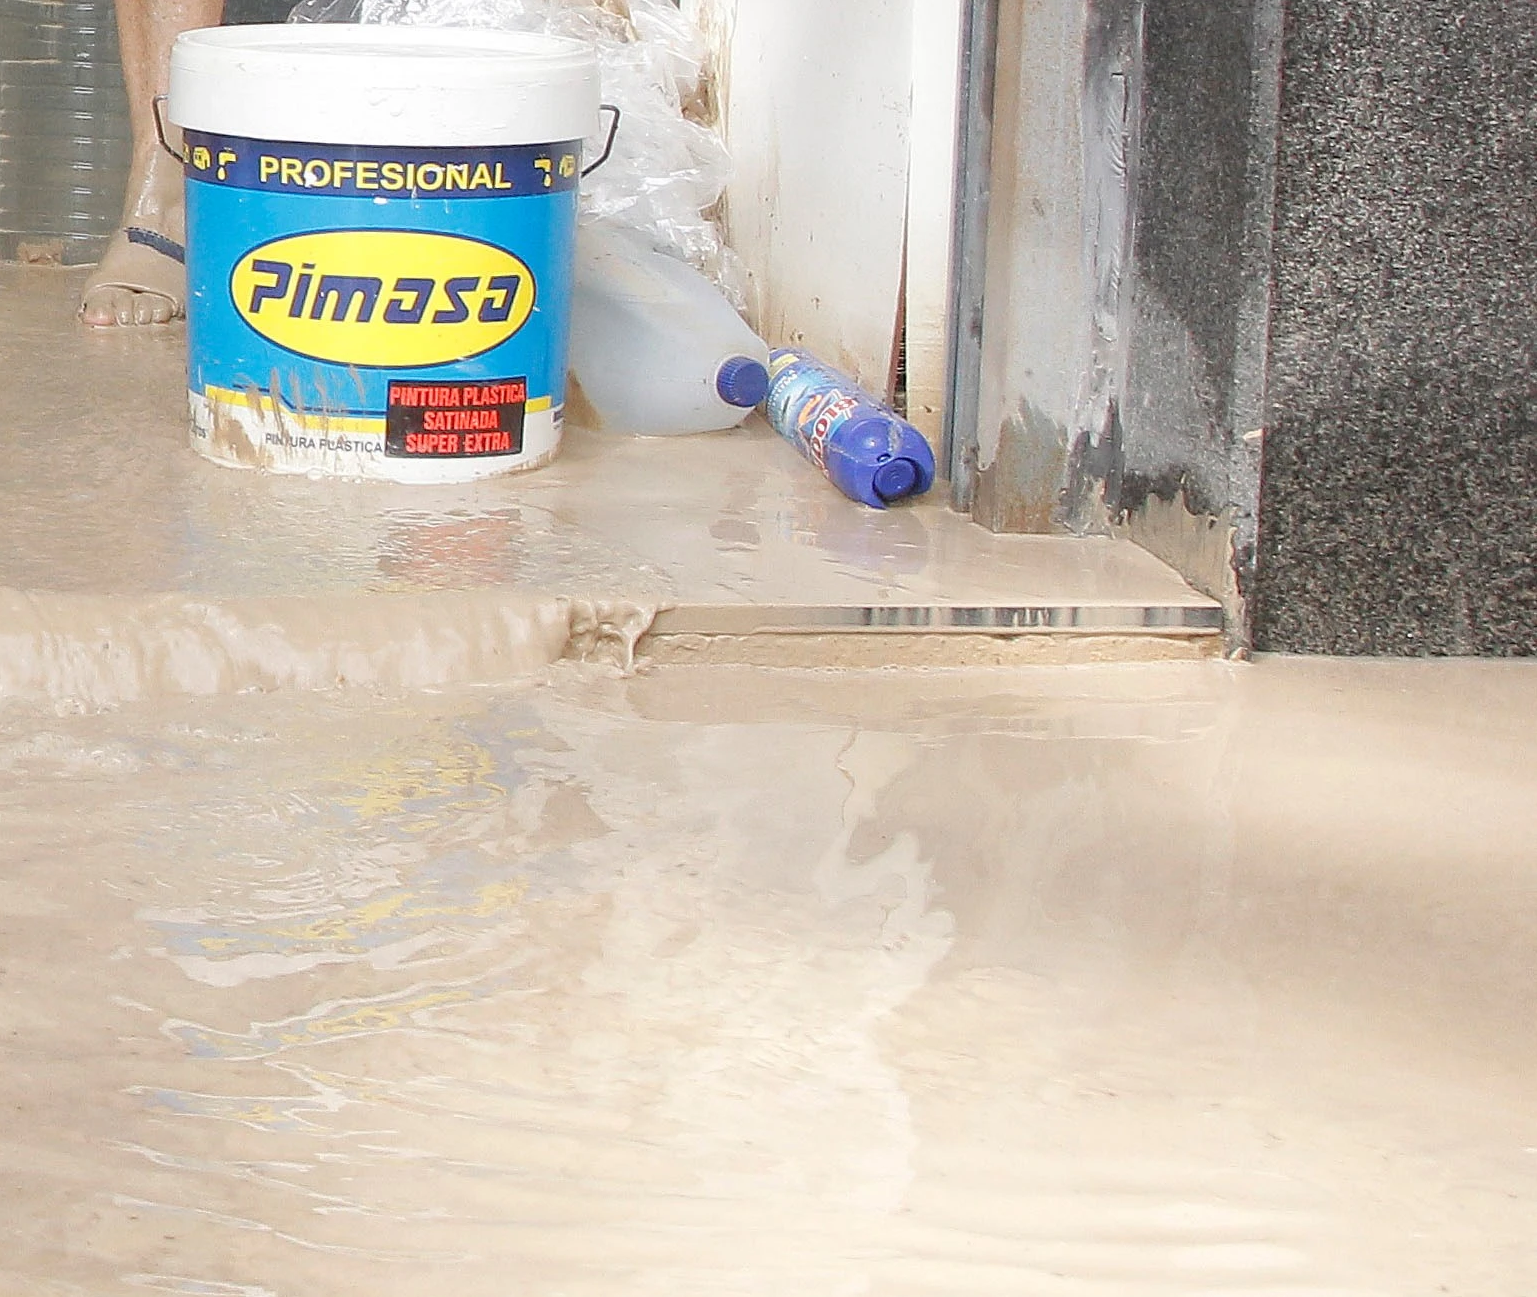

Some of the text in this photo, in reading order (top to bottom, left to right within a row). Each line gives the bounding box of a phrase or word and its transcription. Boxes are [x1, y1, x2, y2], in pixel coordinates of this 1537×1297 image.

[259, 156, 512, 191] PROFESIONAL
[248, 258, 522, 325] Pimasa
[390, 383, 525, 407] PINTURA PLASTICA
[424, 409, 499, 431] SATINADA
[406, 431, 511, 454] SUPER EXTRA
